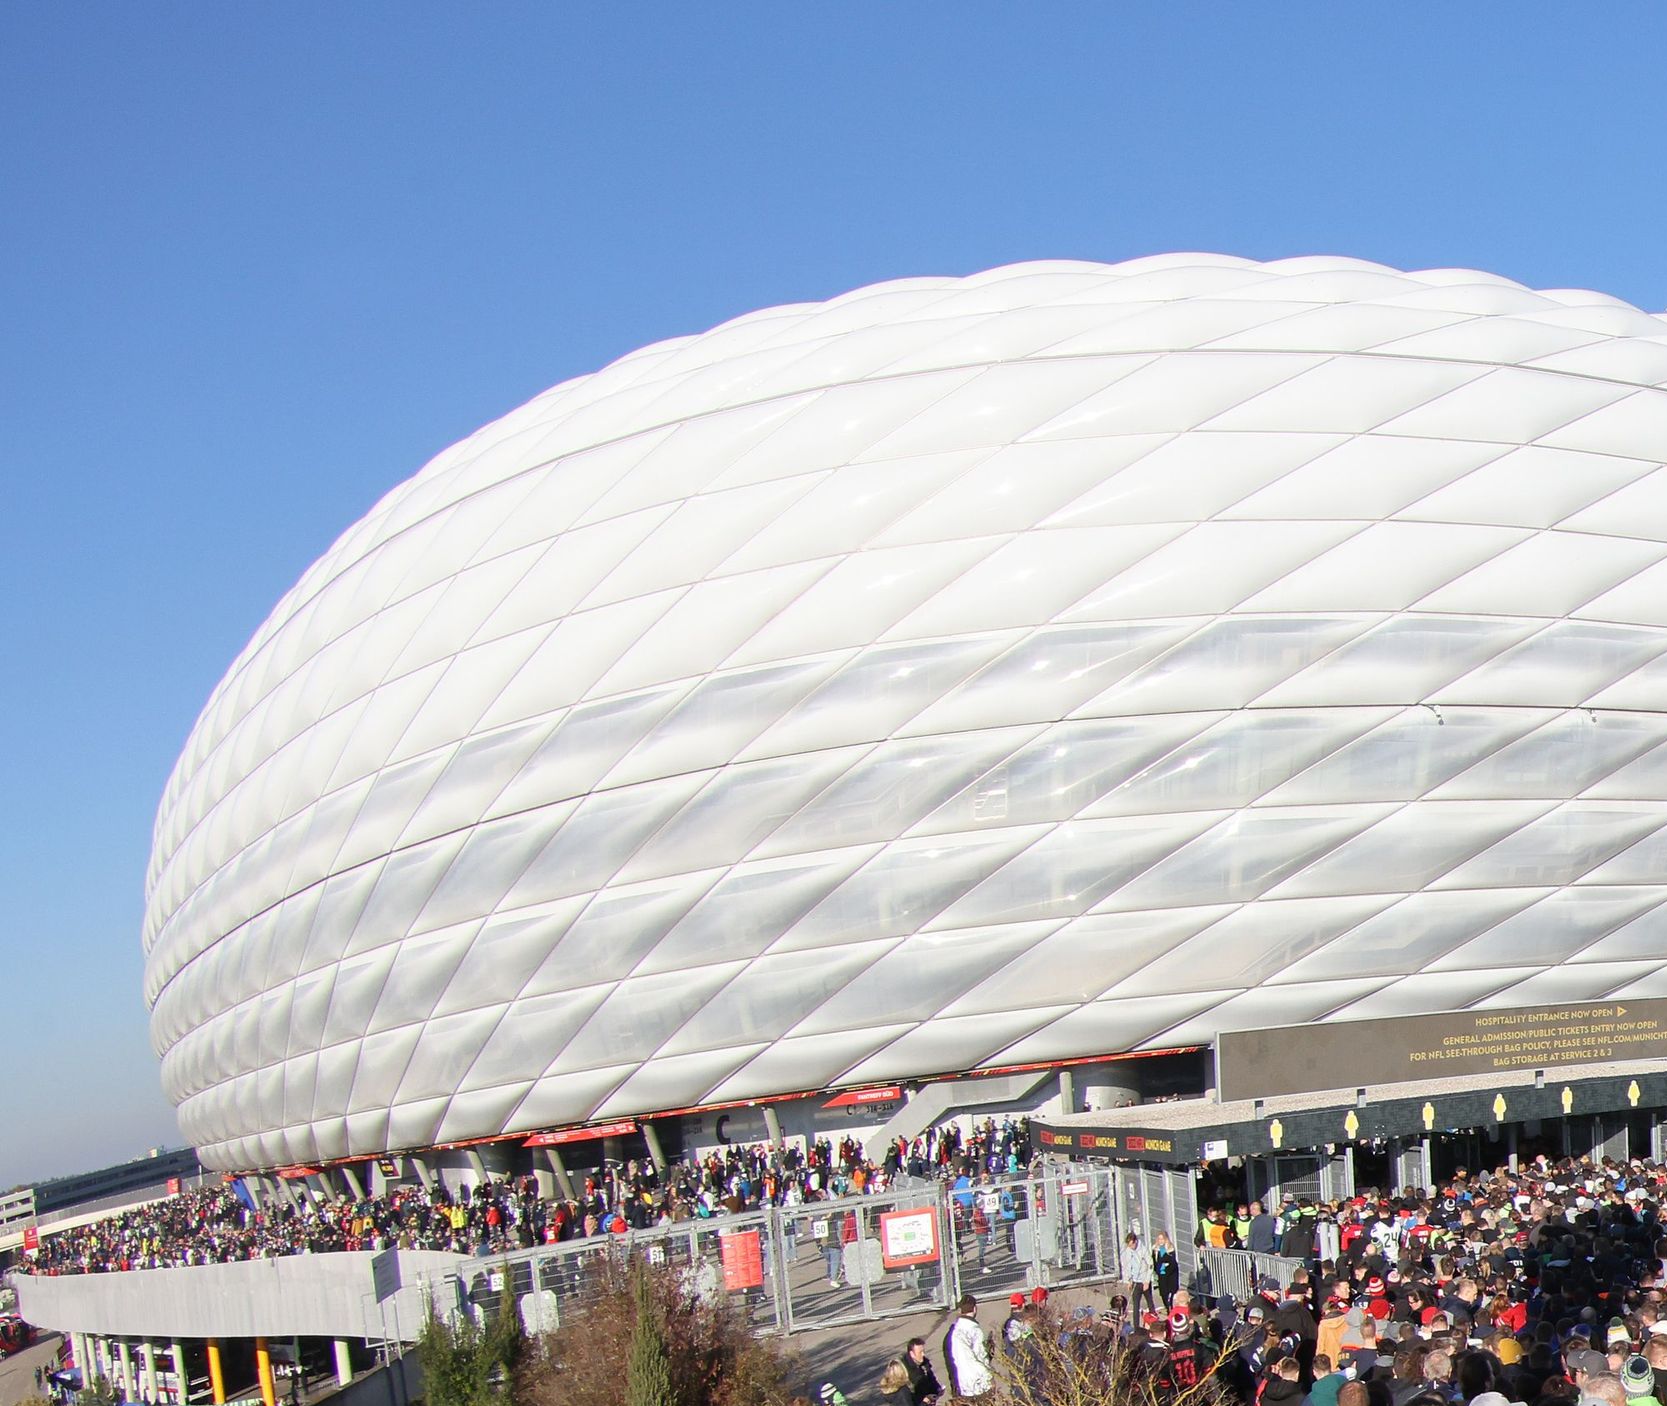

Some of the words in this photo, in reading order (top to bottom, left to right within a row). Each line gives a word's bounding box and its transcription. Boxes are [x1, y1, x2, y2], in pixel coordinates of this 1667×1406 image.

[1475, 1014, 1527, 1026] HOSPITALITY
[1528, 1012, 1569, 1023] ENTRANCE
[1570, 1010, 1590, 1020] NOW
[1592, 1008, 1613, 1018] OPEN
[1443, 1034, 1480, 1046] GENERAL
[1482, 1028, 1557, 1042] ADMISSION/PUBLIC
[1558, 1025, 1589, 1036] TICKETS
[1590, 1023, 1615, 1033] ENTRY
[1616, 1022, 1635, 1032] NOW
[1637, 1020, 1658, 1030] OPEN
[1410, 1051, 1426, 1062] FOR
[1428, 1050, 1444, 1060] NFL
[1445, 1045, 1503, 1059] SEE-THROUGH
[1504, 1043, 1521, 1053] BAG
[1553, 1038, 1581, 1049] PLEASE
[1582, 1037, 1596, 1047] SEE
[1493, 1057, 1510, 1067] BAG
[1511, 1054, 1548, 1065] STORAGE
[1549, 1052, 1560, 1062] AT
[1561, 1050, 1592, 1061] SERVICE
[1593, 1049, 1599, 1058] 2
[1607, 1048, 1612, 1057] 3
[716, 1115, 731, 1144] C
[816, 1225, 826, 1235] 50
[1384, 1232, 1399, 1248] 24
[493, 1277, 503, 1288] 52
